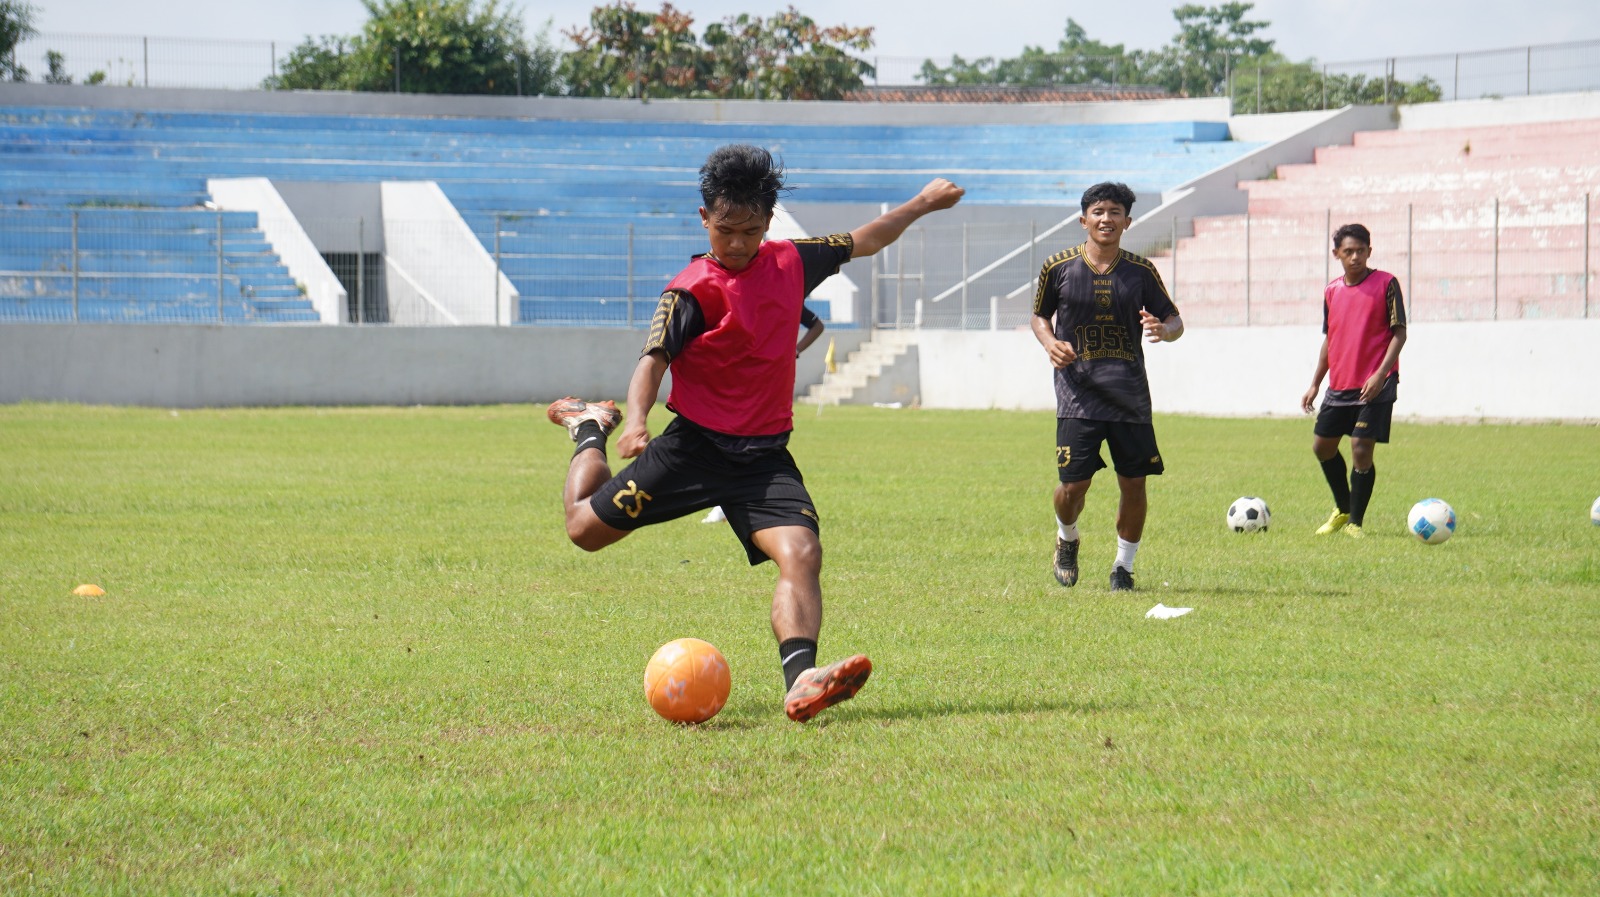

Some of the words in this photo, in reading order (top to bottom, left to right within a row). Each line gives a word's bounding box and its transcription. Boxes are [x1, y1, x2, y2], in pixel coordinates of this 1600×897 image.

[1107, 349, 1135, 362] JEMBER
[1056, 446, 1071, 468] 23
[612, 479, 653, 519] 25
